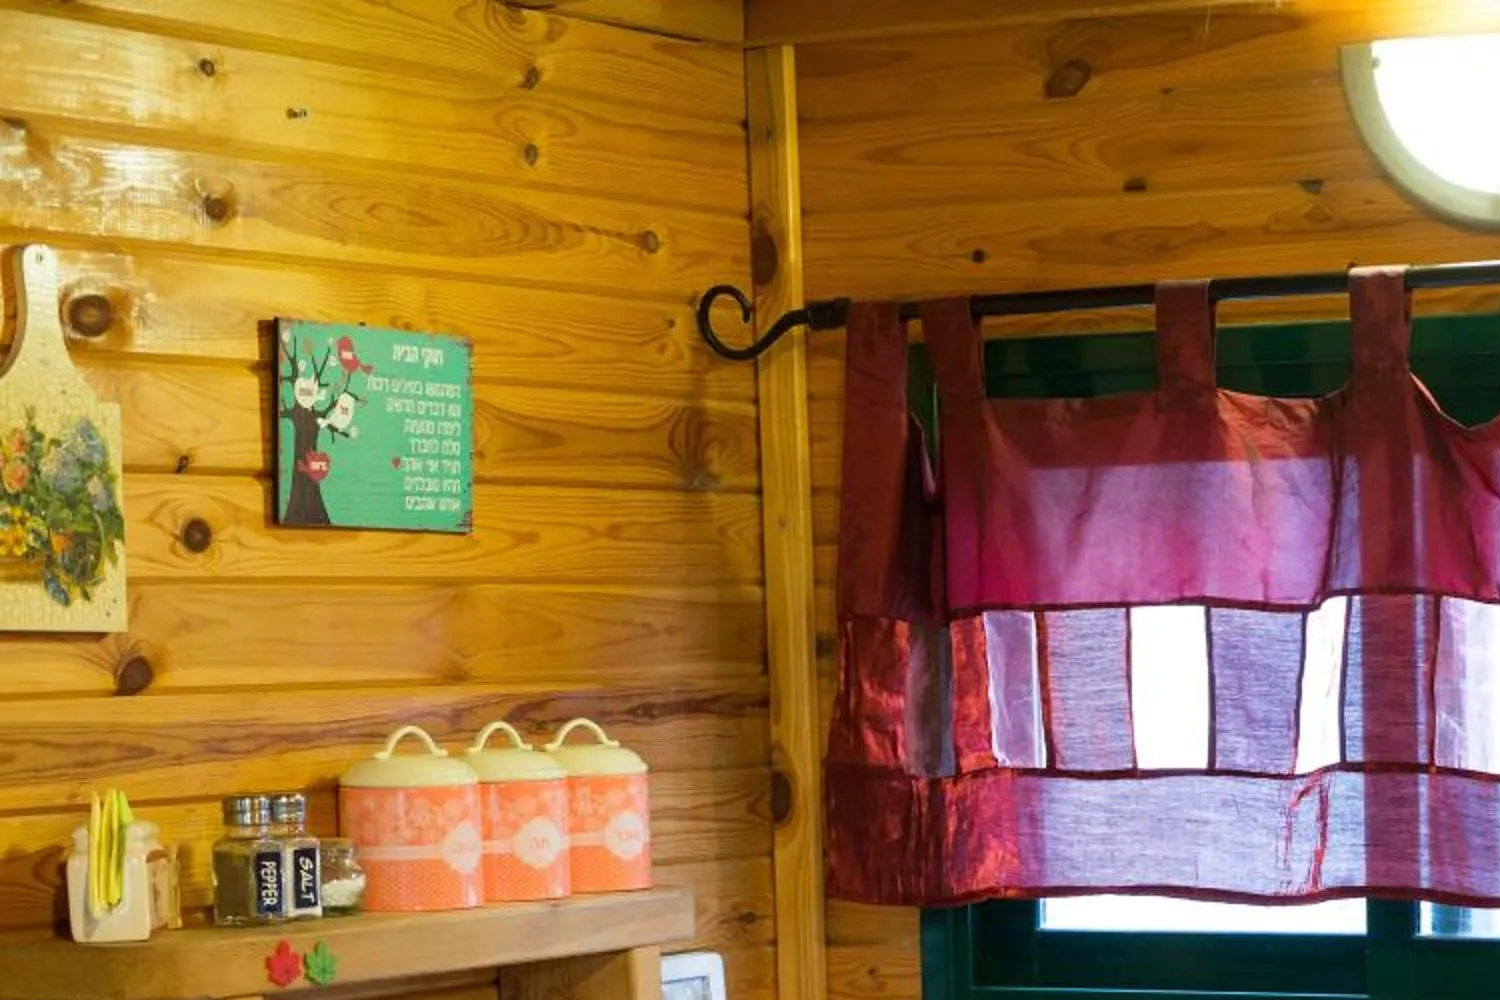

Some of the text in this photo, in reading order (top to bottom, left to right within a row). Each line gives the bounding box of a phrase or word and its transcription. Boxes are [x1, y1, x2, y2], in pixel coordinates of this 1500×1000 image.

[393, 344, 443, 368] חוקי הבית
[261, 861, 279, 906] PEPPER
[299, 857, 314, 903] SALT
